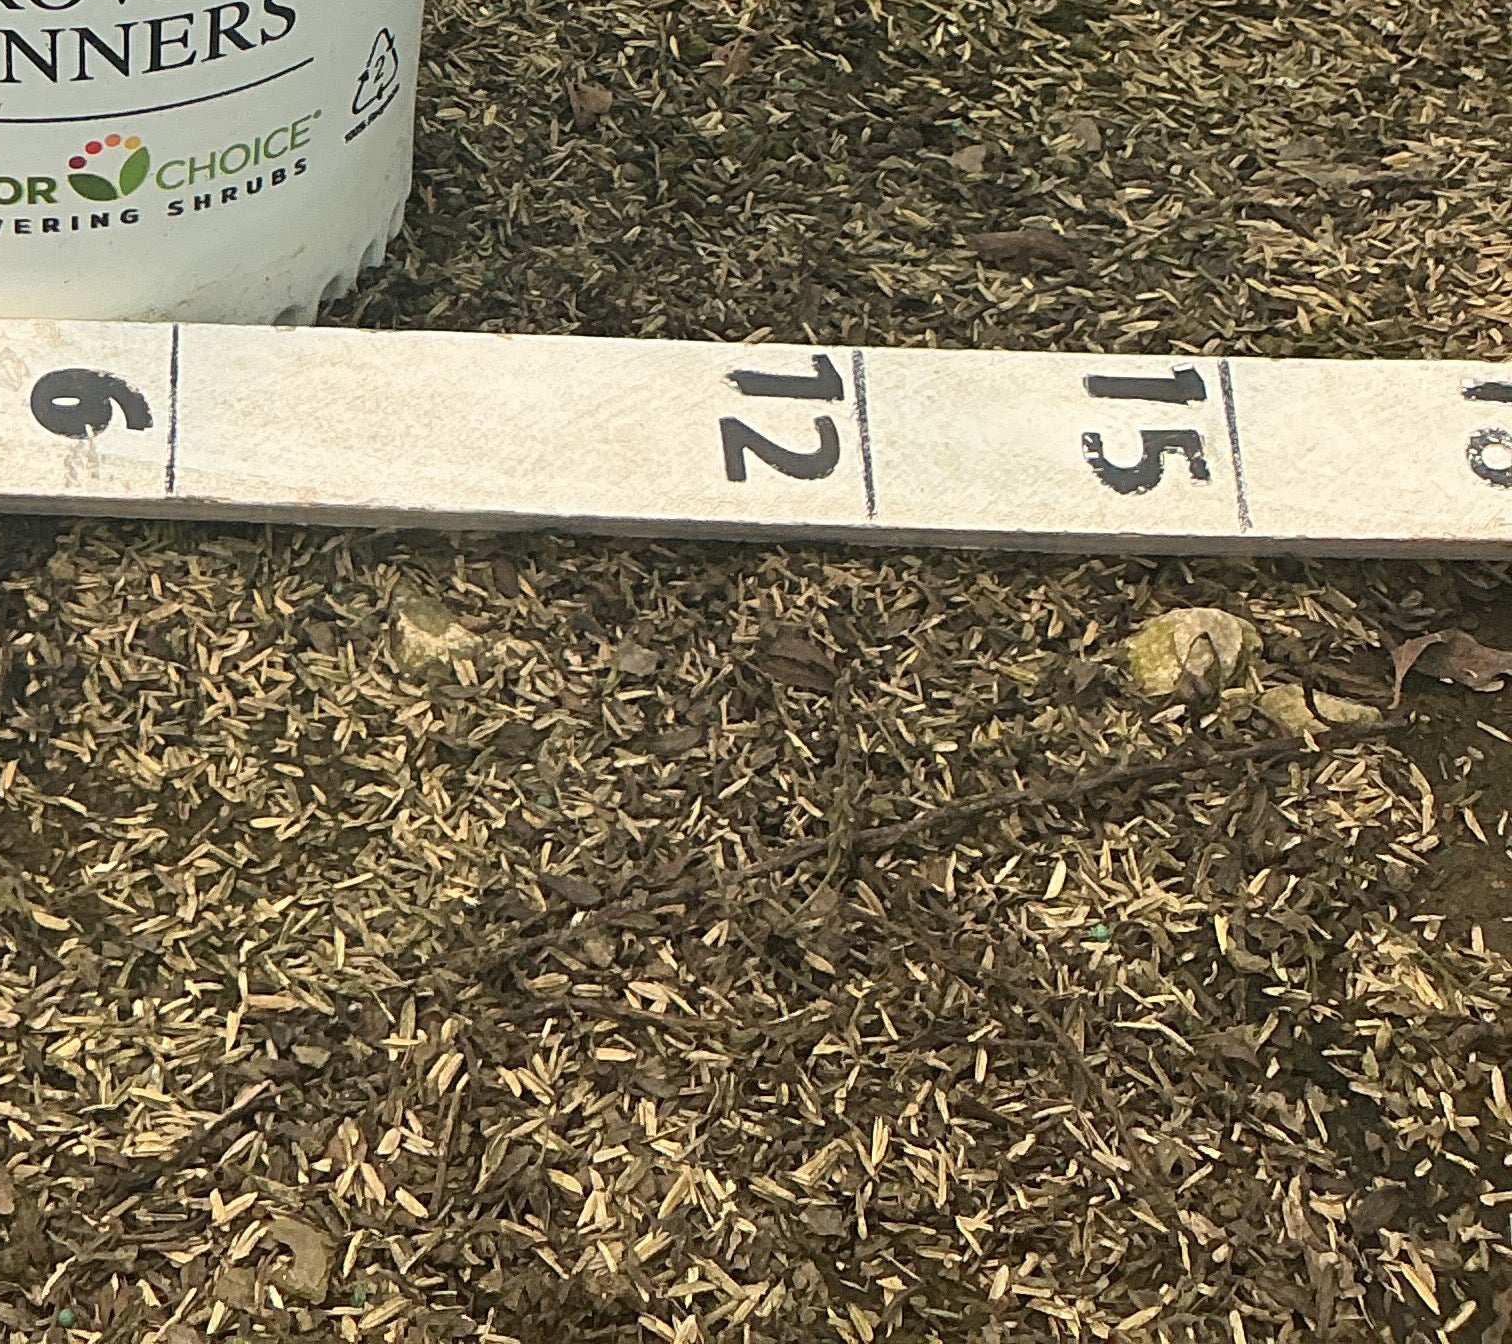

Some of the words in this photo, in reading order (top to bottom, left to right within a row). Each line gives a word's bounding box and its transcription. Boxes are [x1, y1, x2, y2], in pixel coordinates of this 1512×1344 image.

[168, 157, 308, 217] SHRUBS
[30, 368, 153, 439] 6
[719, 354, 844, 482] 12
[1082, 365, 1211, 495] 15
